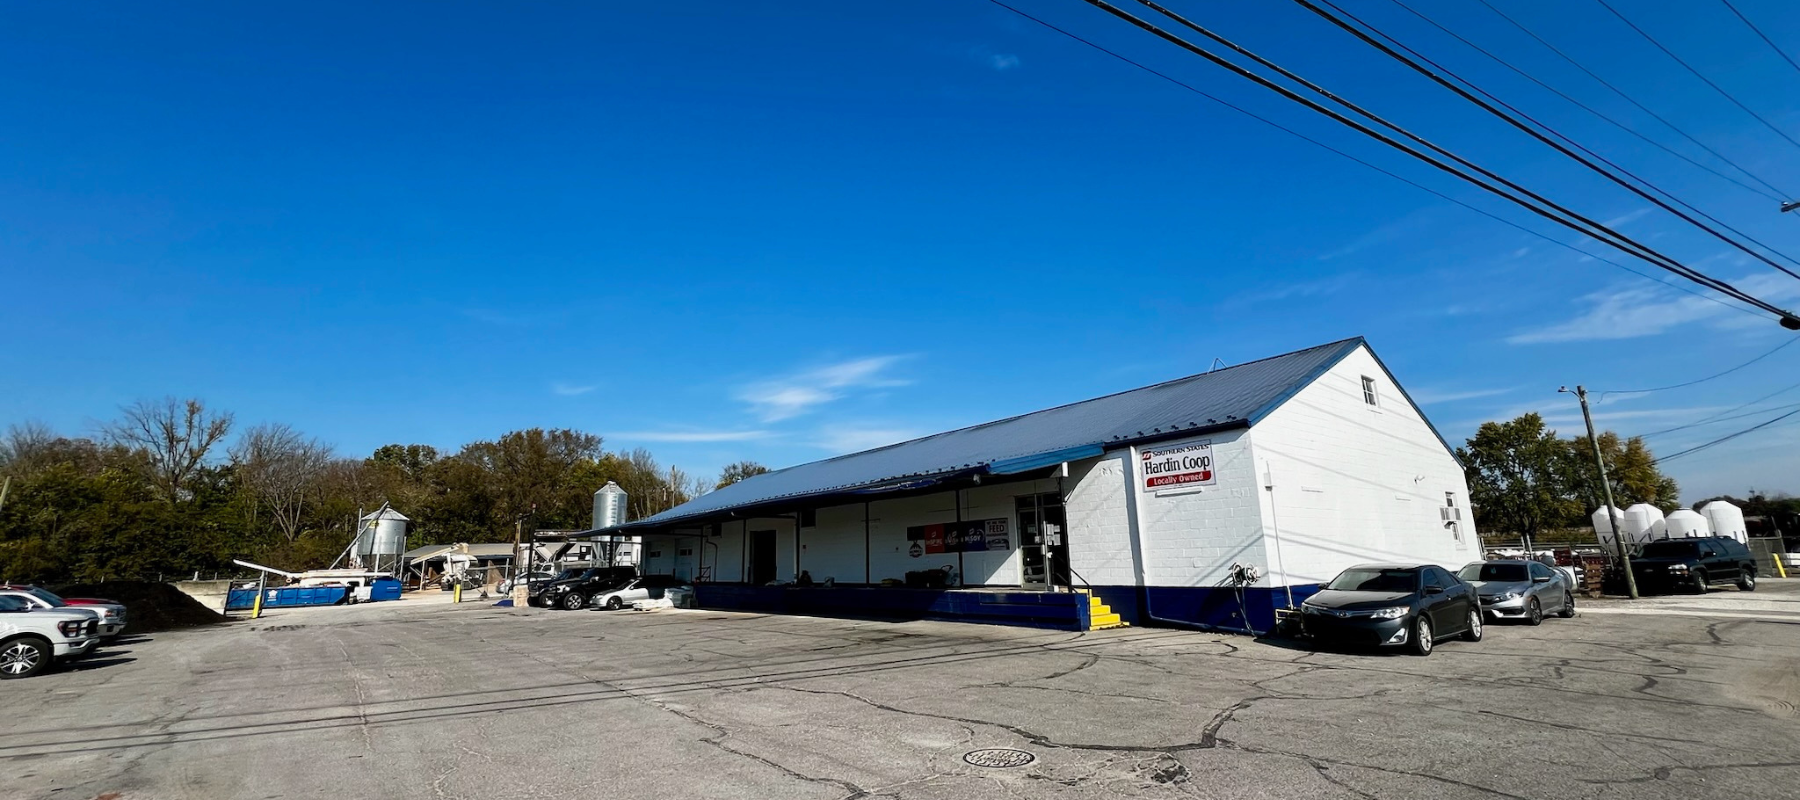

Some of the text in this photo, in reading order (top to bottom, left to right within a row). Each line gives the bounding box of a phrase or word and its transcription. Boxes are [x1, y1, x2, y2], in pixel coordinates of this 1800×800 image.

[1145, 455, 1210, 475] Hardin Coop
[1153, 472, 1204, 486] Locally Owned
[989, 525, 1004, 533] FEED
